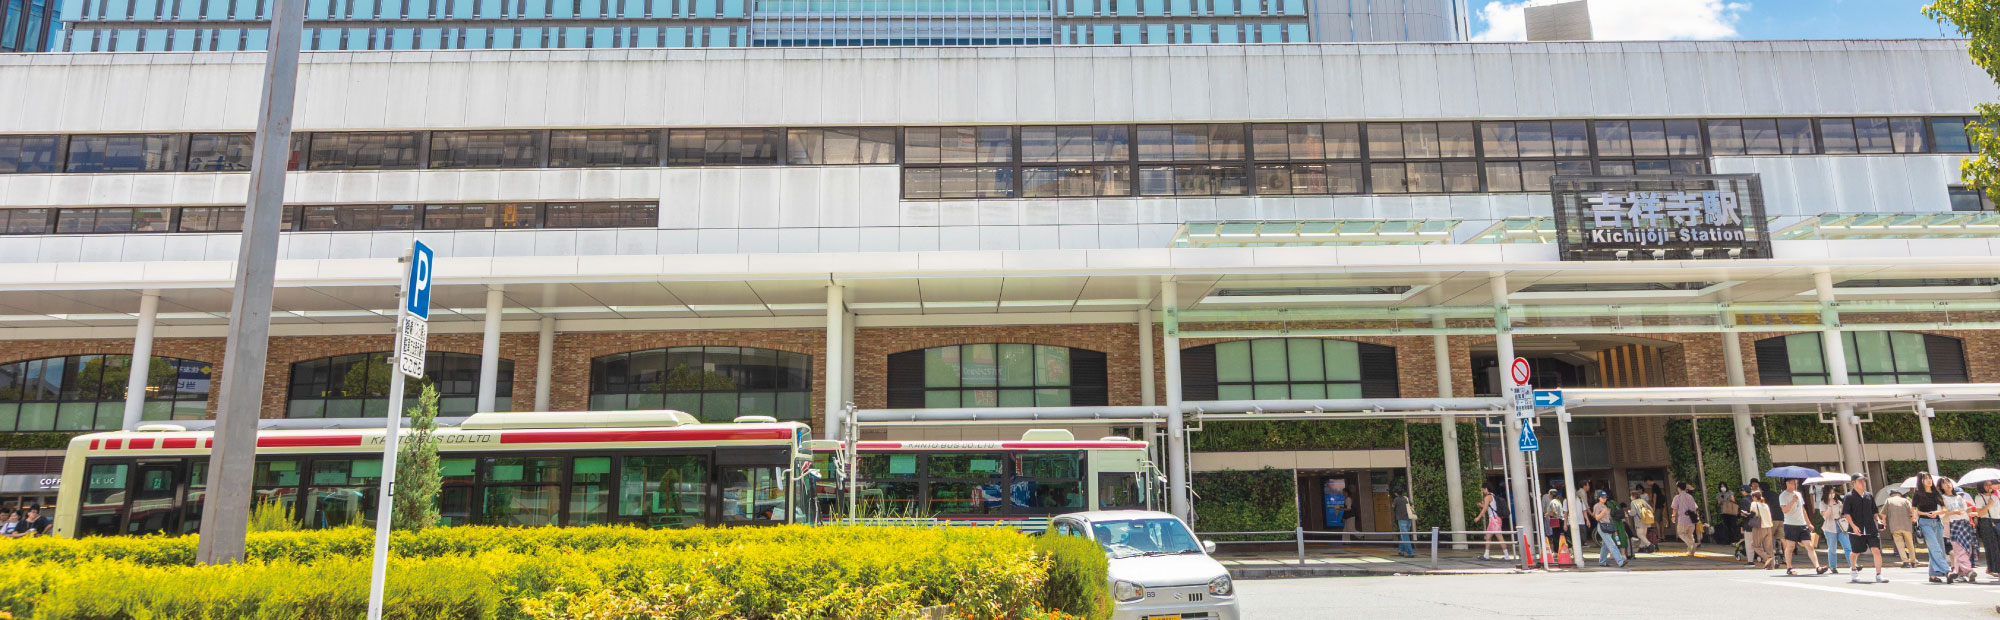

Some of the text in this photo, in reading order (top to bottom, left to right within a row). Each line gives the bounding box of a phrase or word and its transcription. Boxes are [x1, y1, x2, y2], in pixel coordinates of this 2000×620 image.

[1588, 191, 1741, 227] 吉祥寺駅
[1680, 228, 1744, 242] Station
[414, 250, 429, 308] P
[371, 435, 413, 444] KATO
